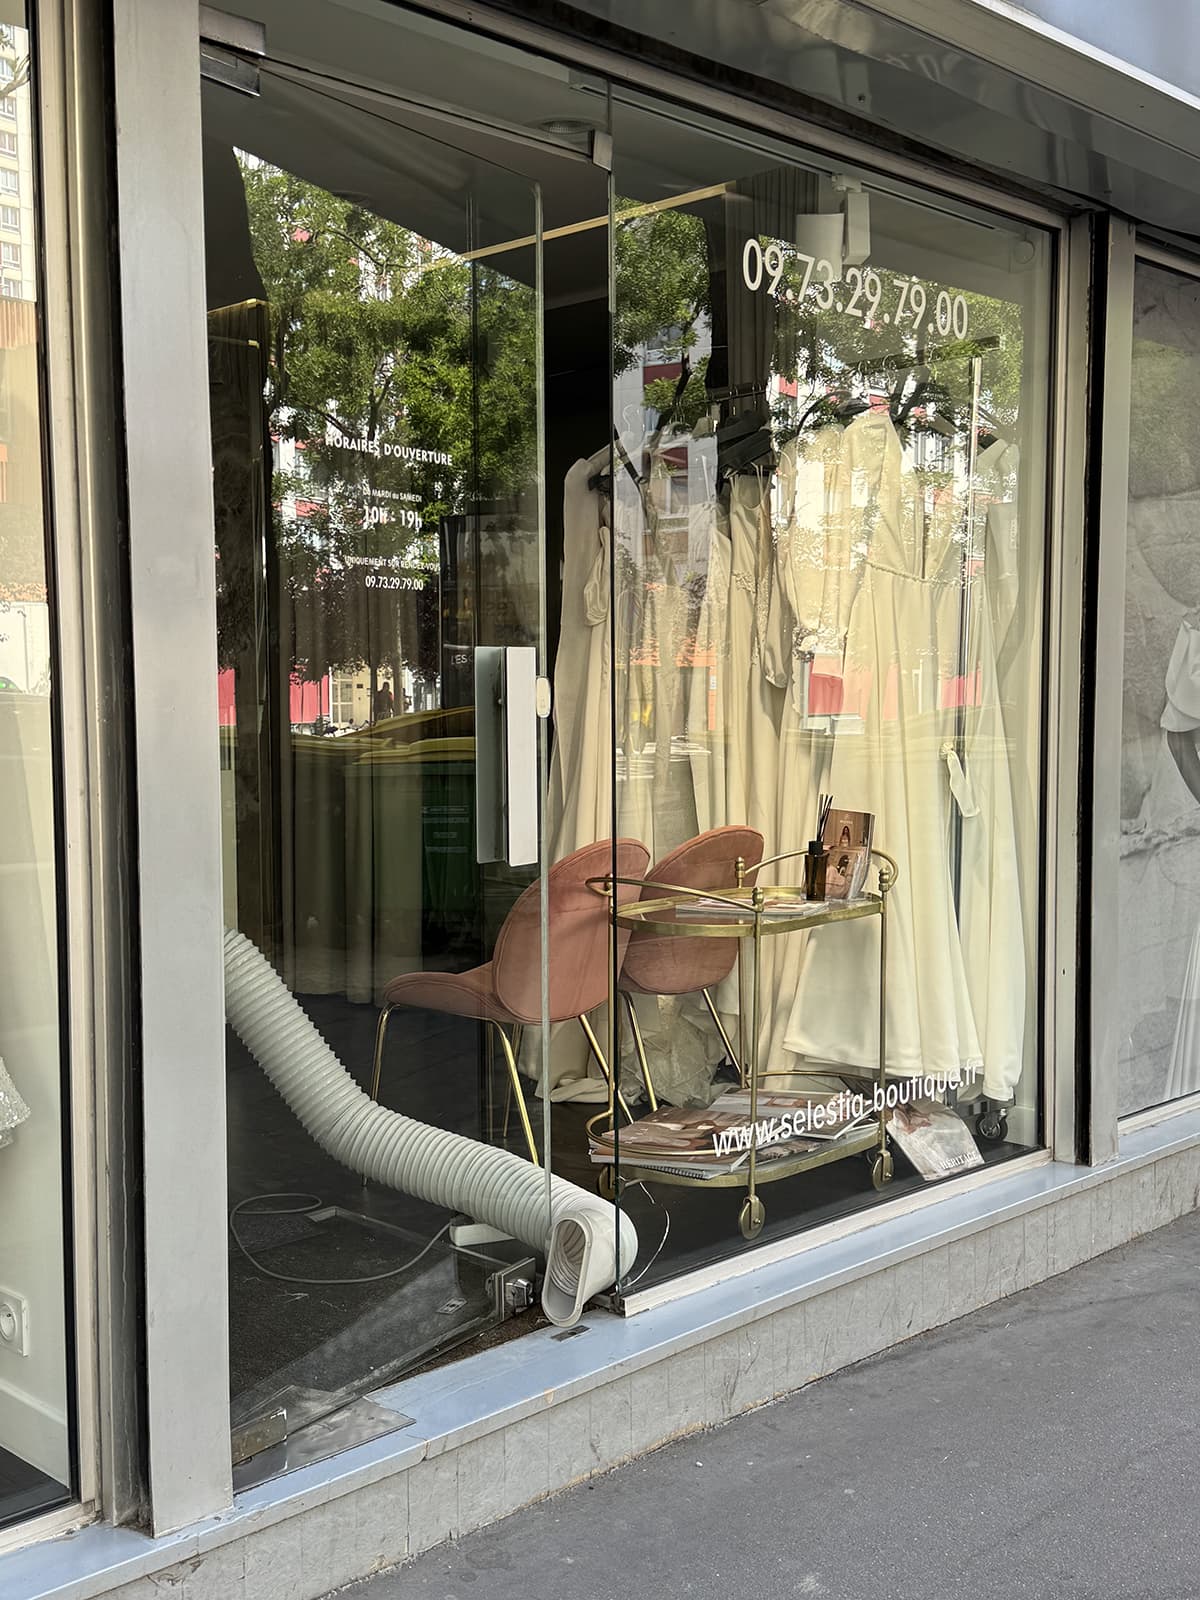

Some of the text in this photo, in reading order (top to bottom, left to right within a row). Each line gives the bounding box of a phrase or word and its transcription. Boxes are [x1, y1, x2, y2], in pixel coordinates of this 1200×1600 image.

[743, 238, 968, 340] 09.73.29.79.00
[325, 435, 453, 466] HORAIRES D'OUVERTURE
[400, 509, 422, 529] 19h
[365, 575, 424, 591] 09.73.29.79.00
[712, 1059, 978, 1157] www.selestia-boutique.fr
